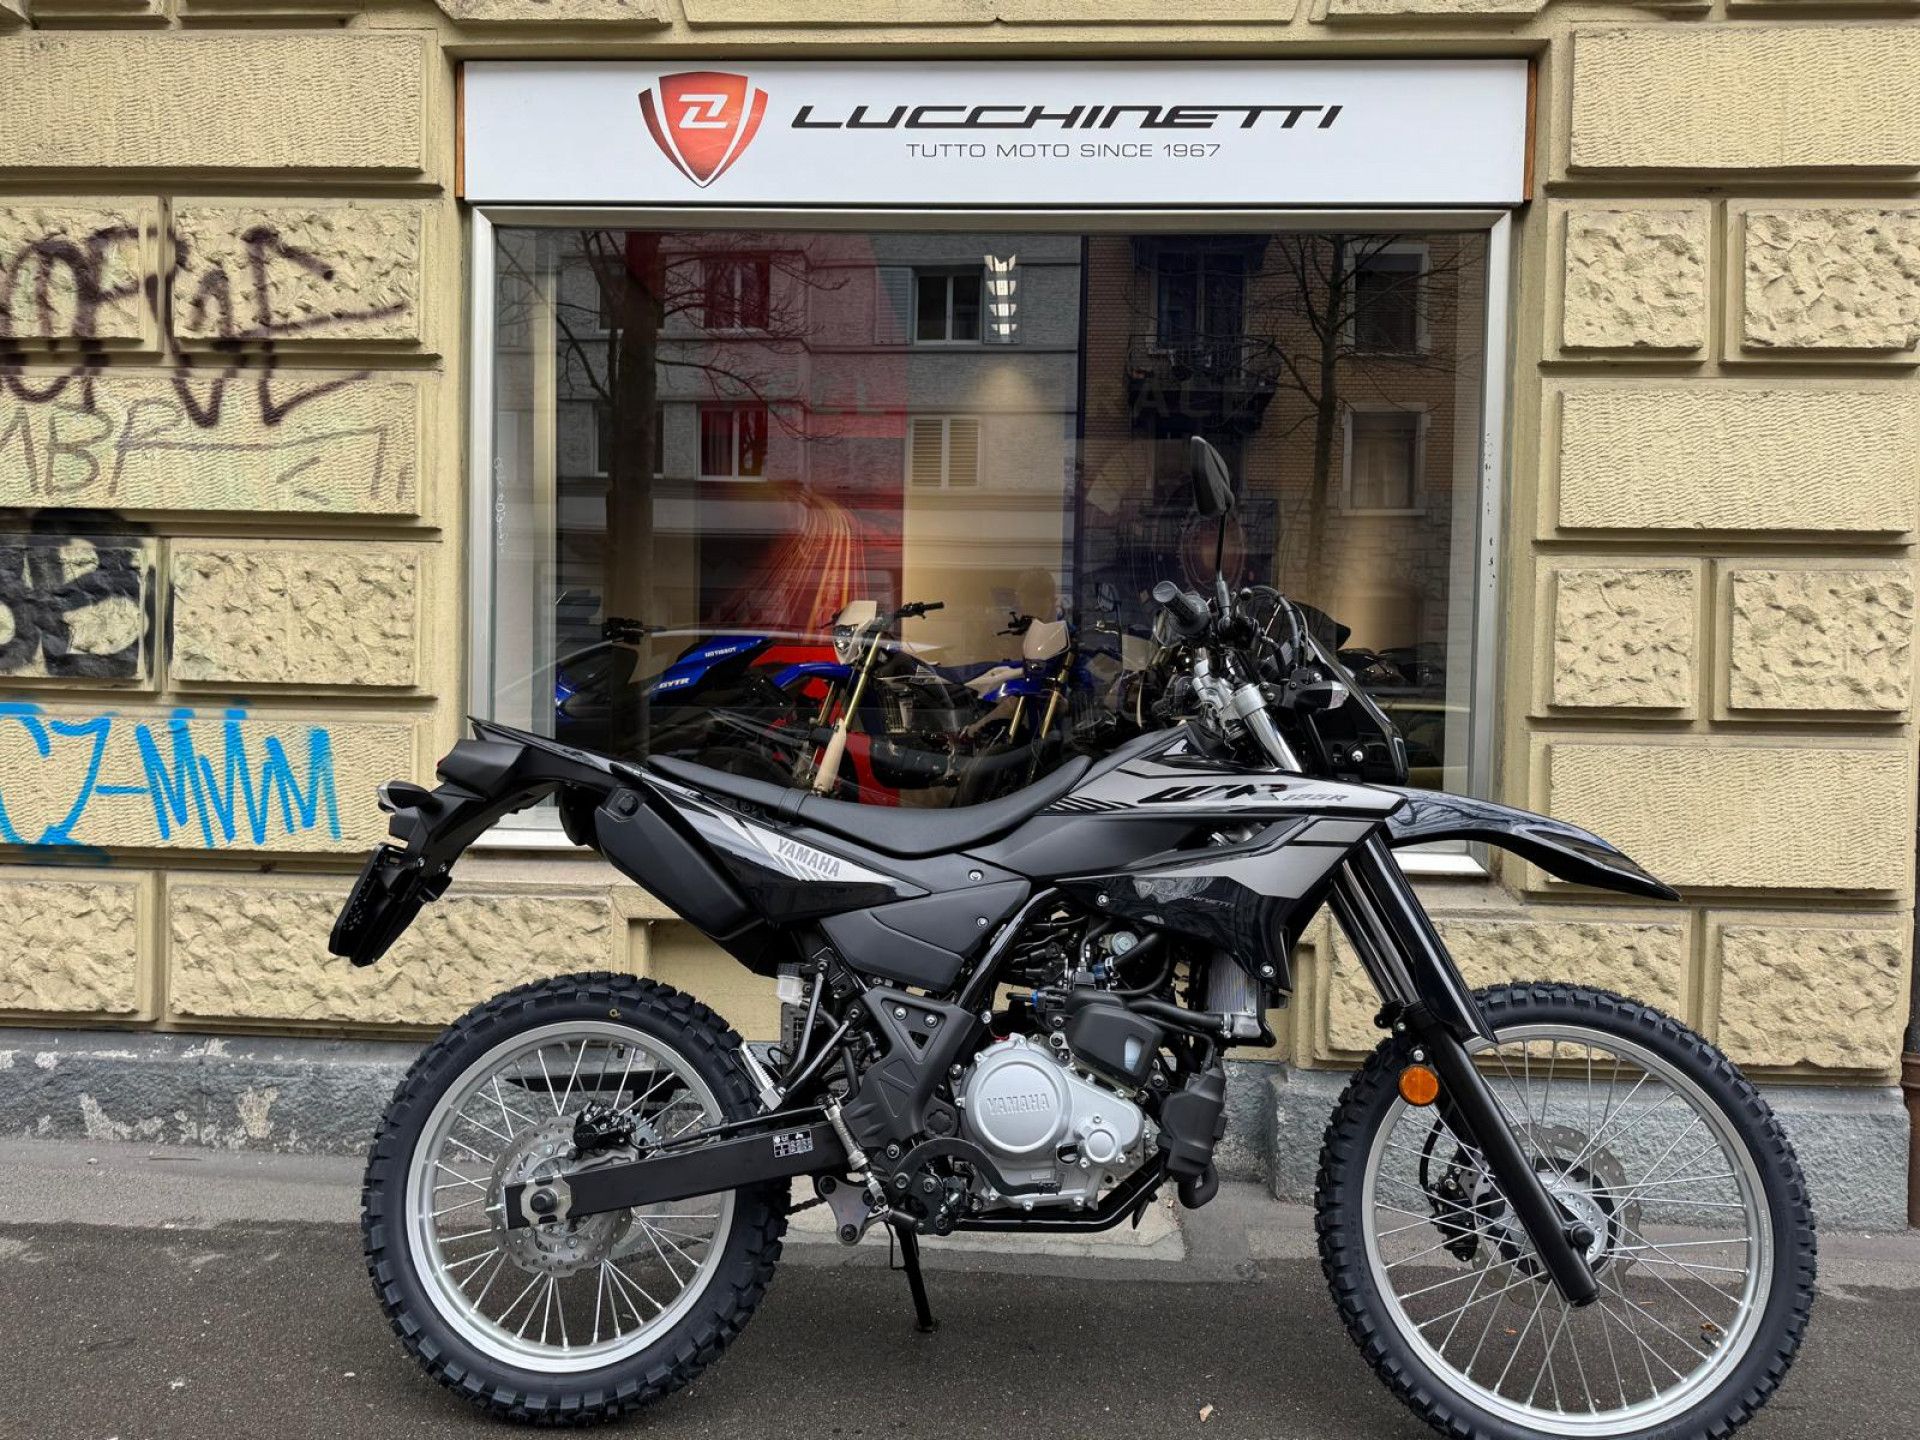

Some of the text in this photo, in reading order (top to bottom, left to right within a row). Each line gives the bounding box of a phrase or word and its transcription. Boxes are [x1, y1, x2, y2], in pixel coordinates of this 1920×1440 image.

[790, 105, 1344, 129] LUCCHINETTI
[905, 143, 1221, 158] TUTTO MOTO SINCE 1967
[778, 839, 840, 877] YAMAHA
[986, 1093, 1051, 1116] YAMAHA
